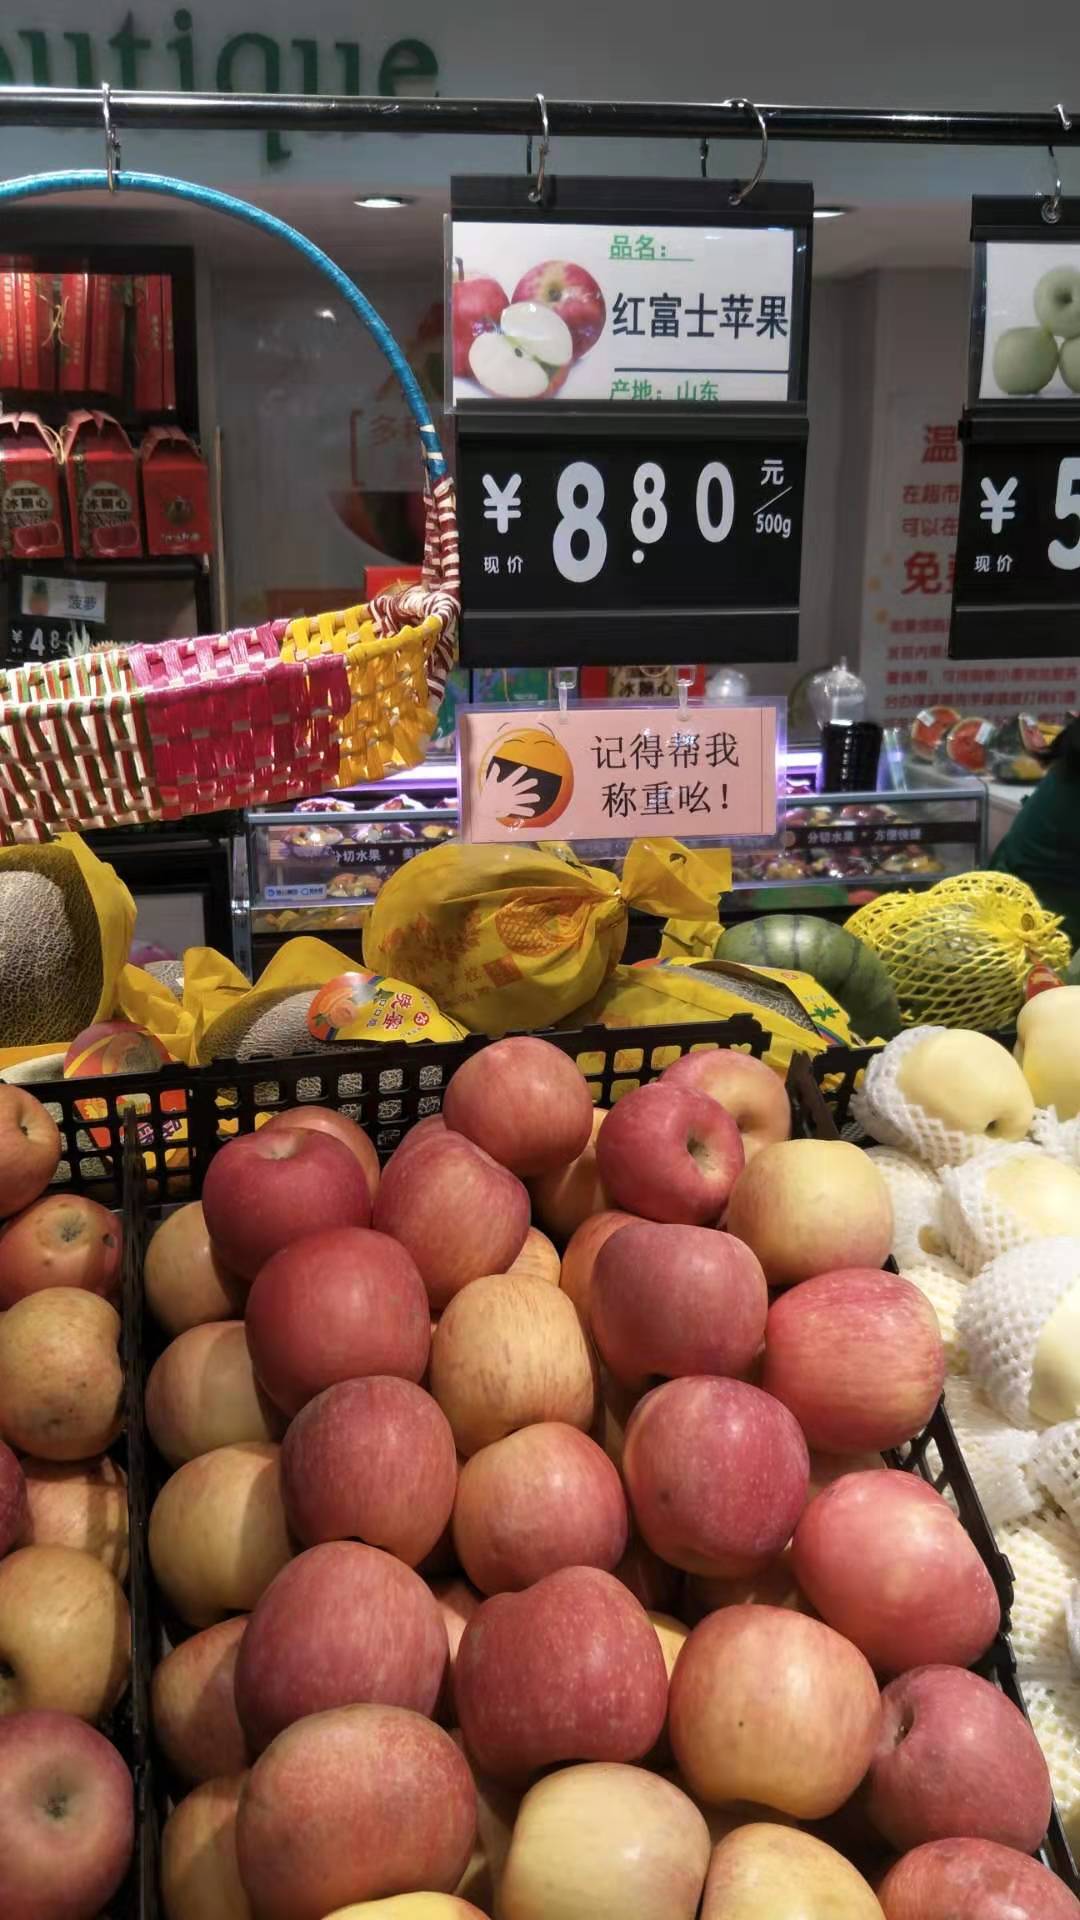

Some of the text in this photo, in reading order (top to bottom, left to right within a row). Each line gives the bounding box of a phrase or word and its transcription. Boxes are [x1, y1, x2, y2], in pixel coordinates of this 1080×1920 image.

[0, 9, 440, 163] utique
[610, 235, 670, 260] 品名：
[612, 292, 789, 340] 红富士苹果
[610, 379, 719, 401] 产地：山东
[552, 461, 735, 583] 8.80
[483, 556, 523, 574] 现价
[902, 552, 957, 595] 免
[974, 555, 1013, 573] 现价
[591, 732, 740, 770] 记得帮我
